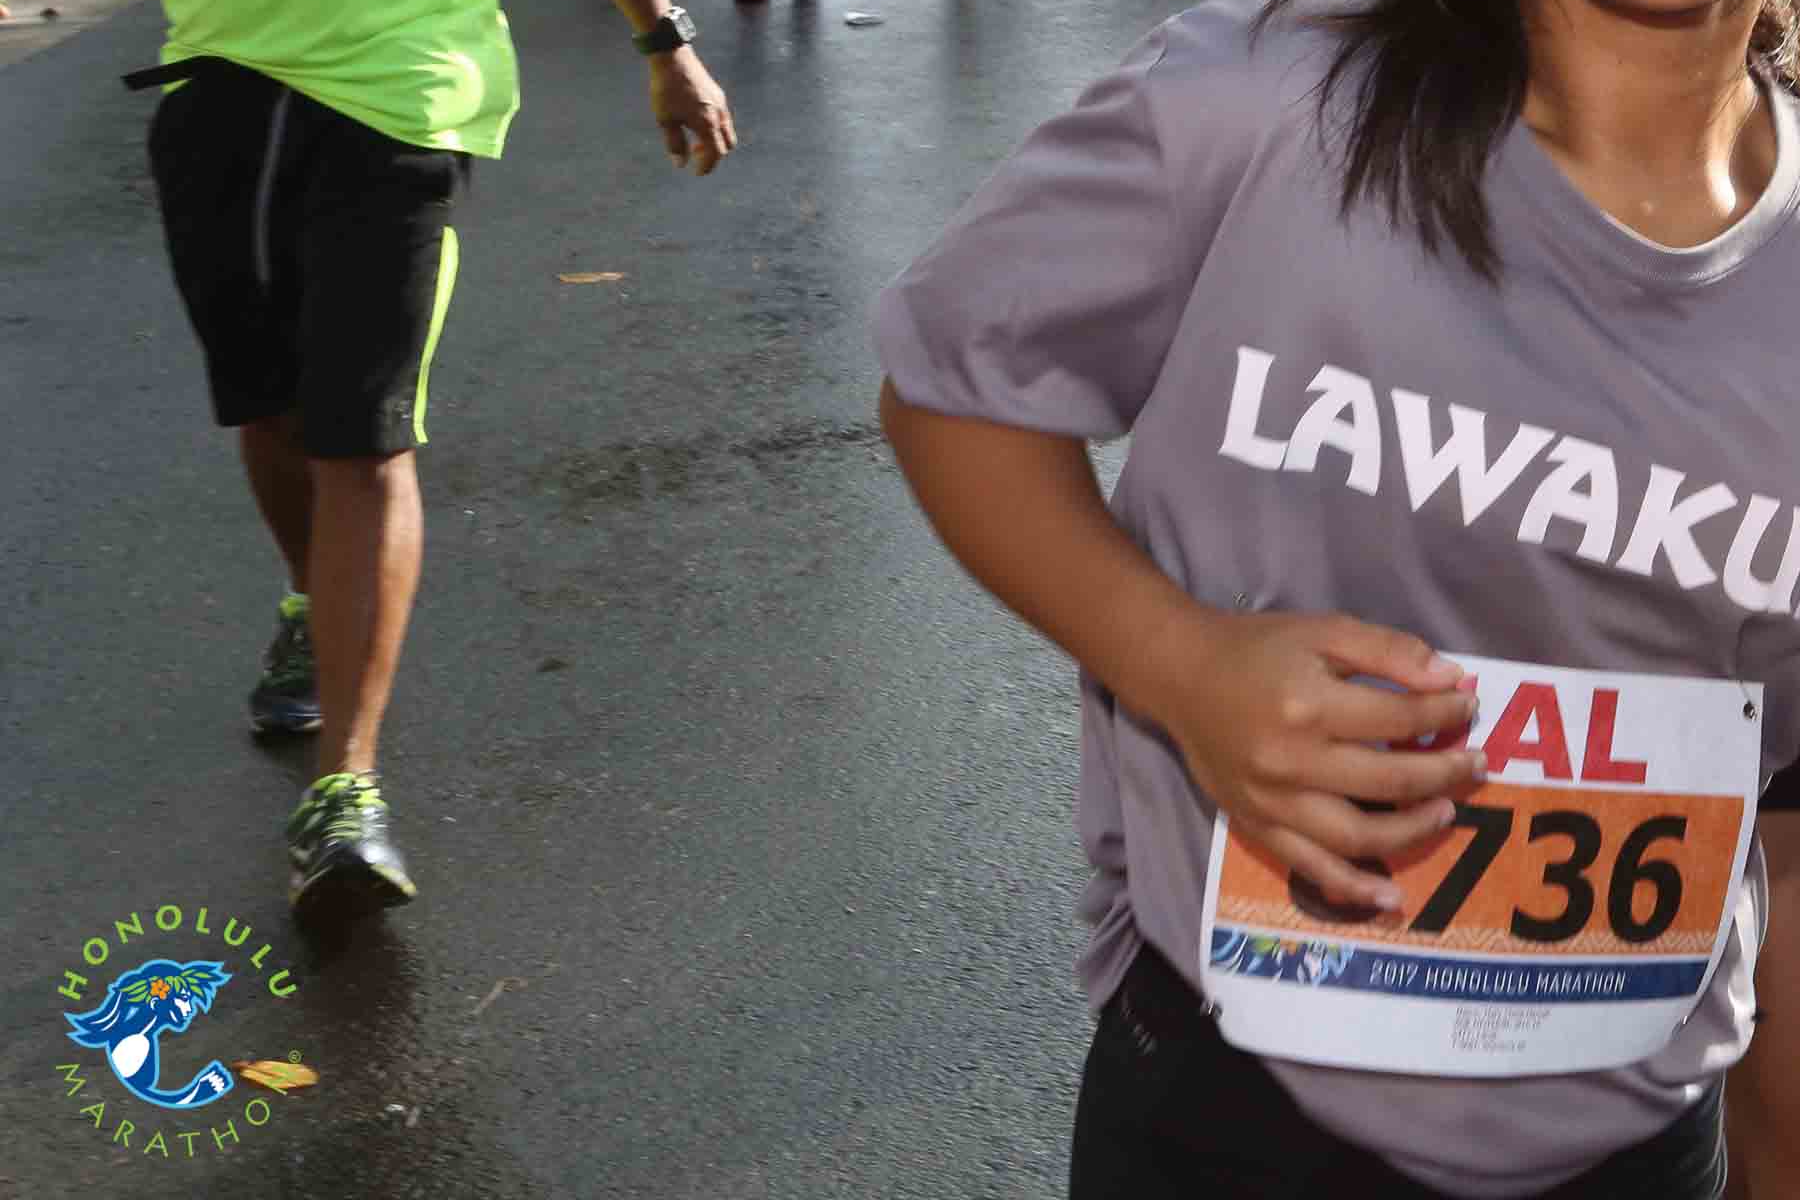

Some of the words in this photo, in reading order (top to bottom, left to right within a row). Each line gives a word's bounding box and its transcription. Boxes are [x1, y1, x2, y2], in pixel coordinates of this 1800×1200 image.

[1369, 958, 1419, 987] 2017
[1424, 963, 1530, 994] HONOLULU
[1535, 970, 1626, 996] MARATHON
